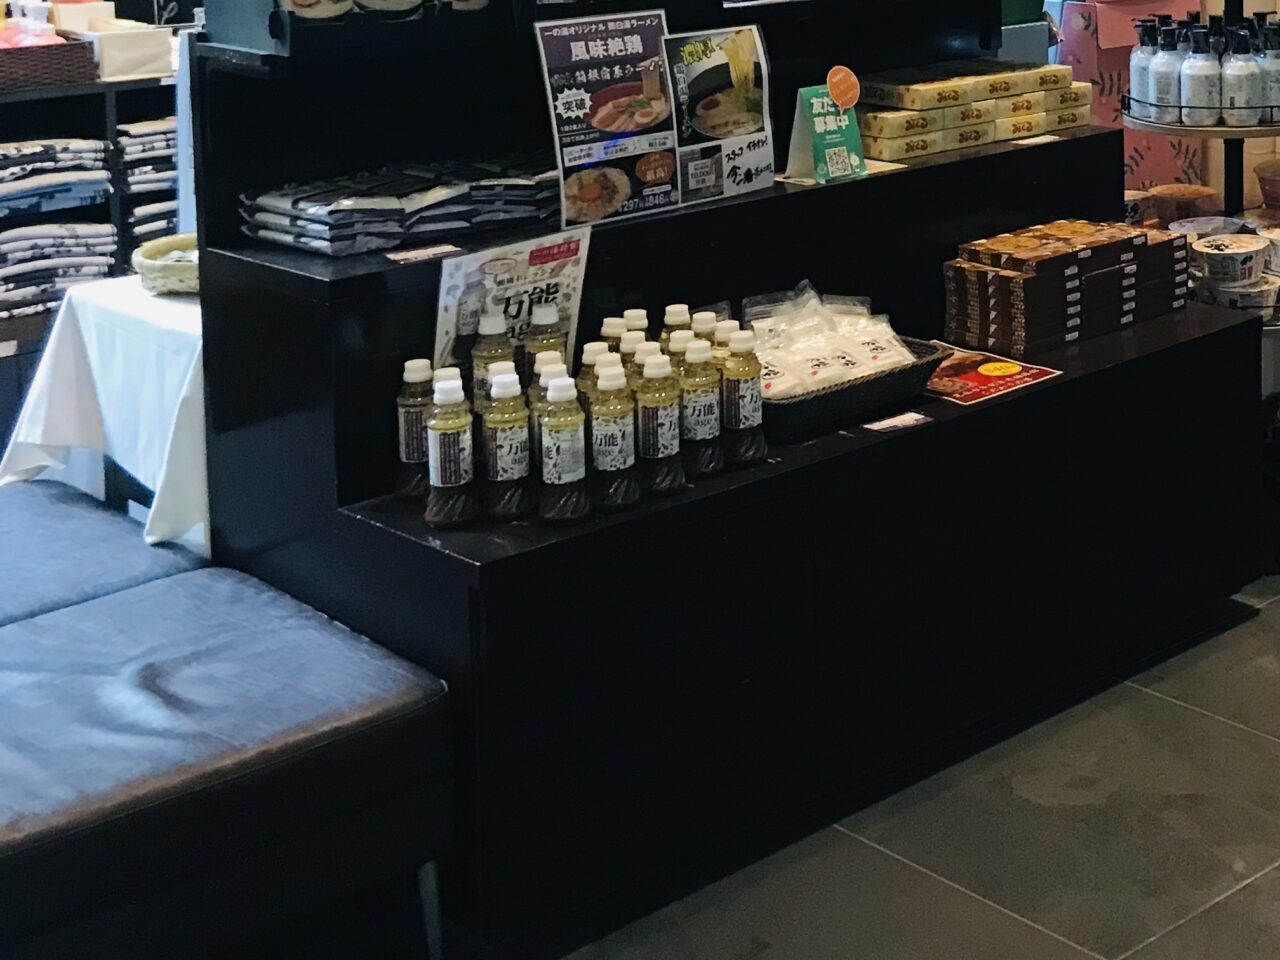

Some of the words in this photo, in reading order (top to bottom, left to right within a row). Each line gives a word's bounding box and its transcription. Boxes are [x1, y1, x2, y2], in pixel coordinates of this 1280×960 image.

[570, 35, 644, 62] 風味絶鶏
[562, 98, 587, 114] 突破
